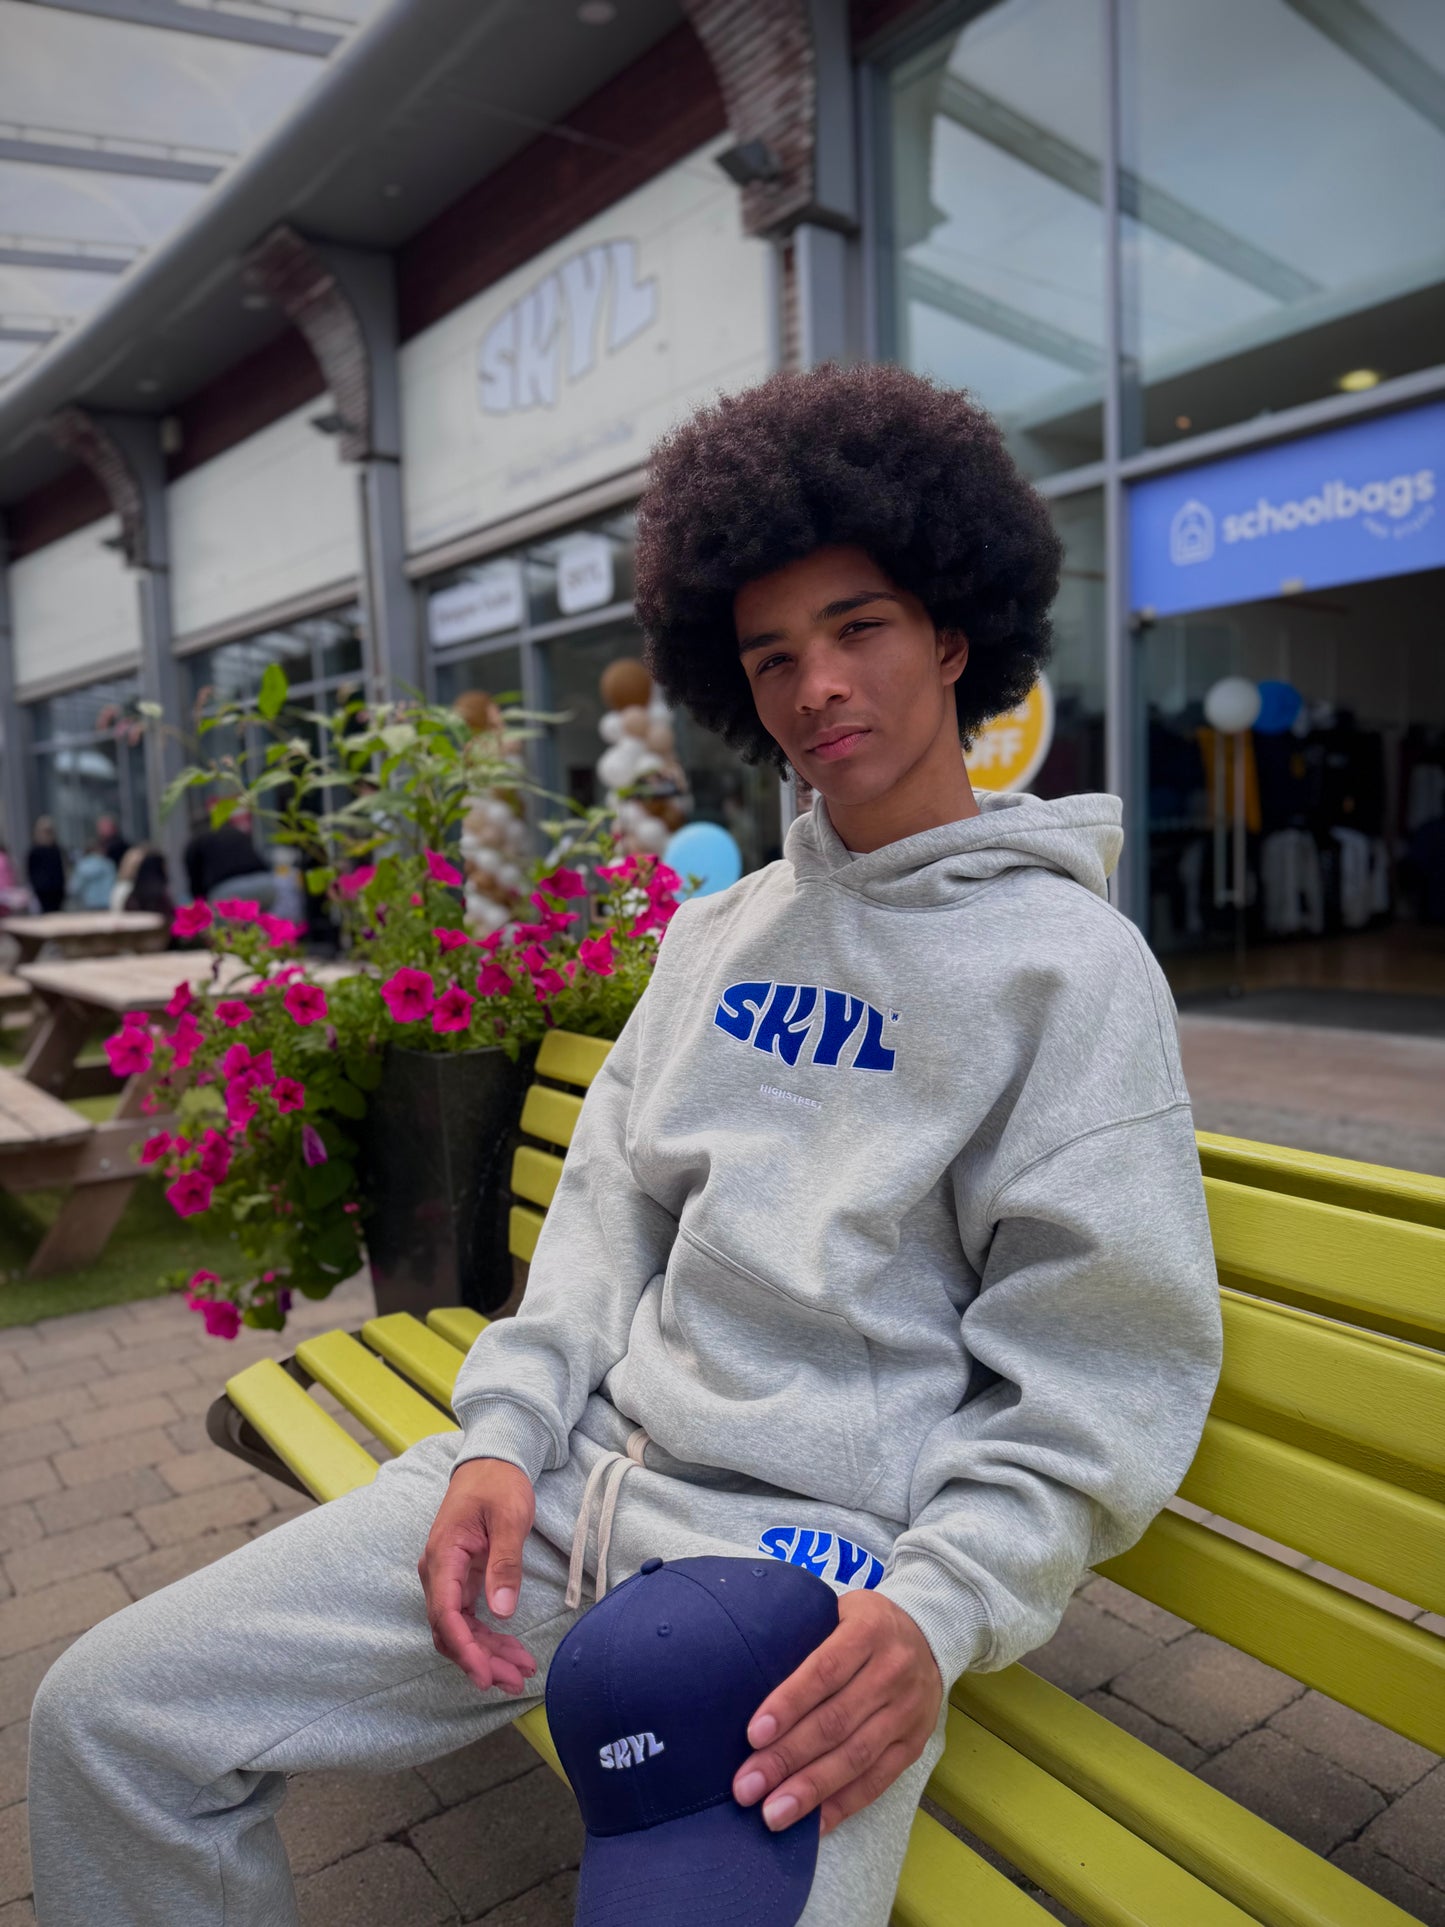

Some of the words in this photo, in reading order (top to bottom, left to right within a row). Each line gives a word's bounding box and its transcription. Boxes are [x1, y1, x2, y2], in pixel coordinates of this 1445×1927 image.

[478, 236, 657, 416] SKYL
[1222, 469, 1435, 544] schoolbags
[714, 980, 897, 1072] SKYL
[760, 1084, 825, 1109] HIGHSTREET
[599, 1732, 665, 1769] SKYL
